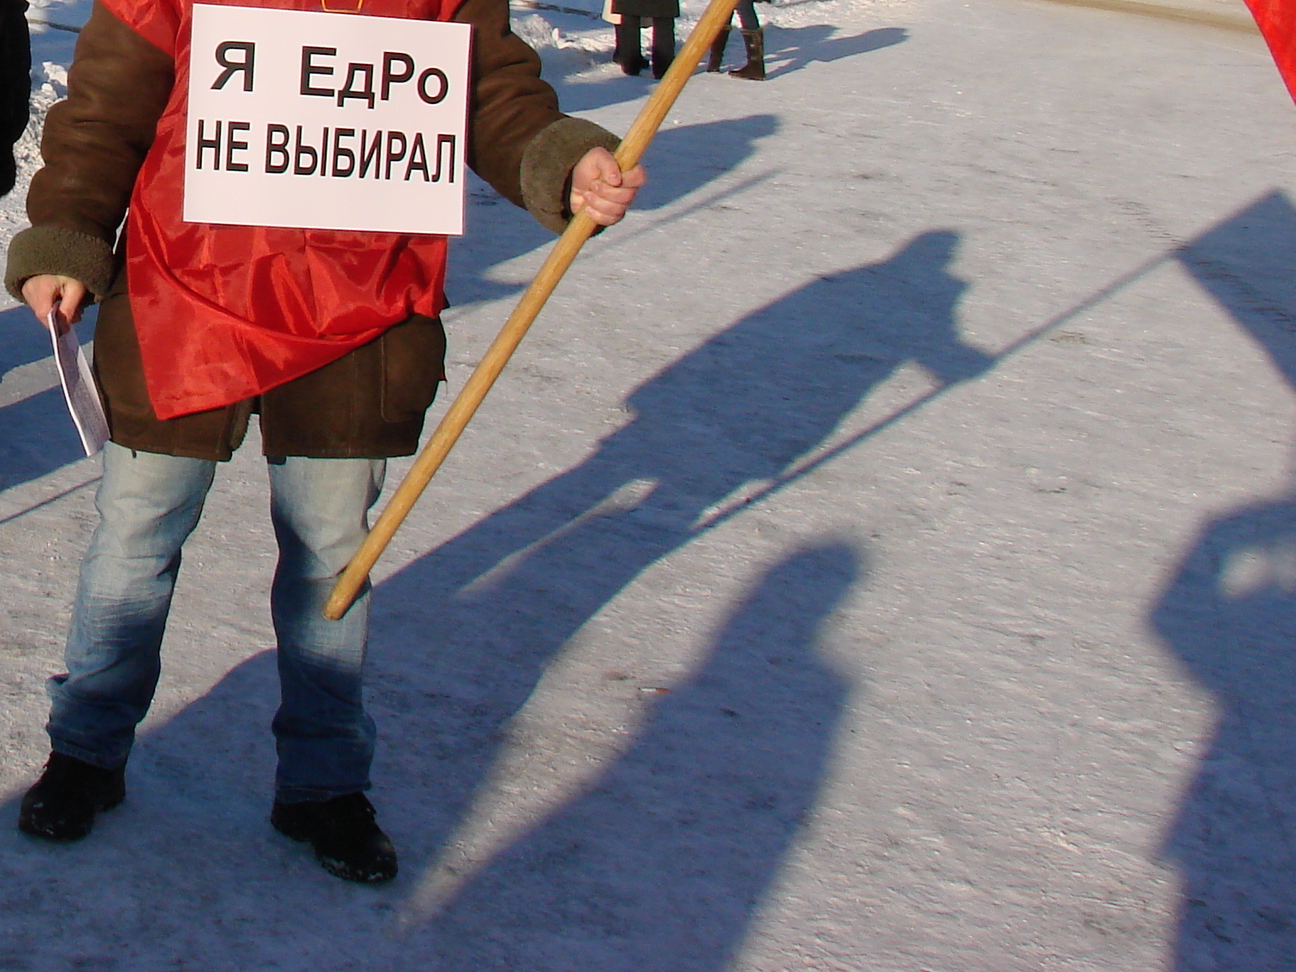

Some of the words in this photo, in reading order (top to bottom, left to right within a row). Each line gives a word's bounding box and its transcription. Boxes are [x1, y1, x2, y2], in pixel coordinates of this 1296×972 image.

[209, 40, 256, 92] Я
[299, 45, 449, 110] ЕдРо
[196, 118, 251, 173] НЕ
[264, 123, 456, 184] ВЫБИРАЛ
